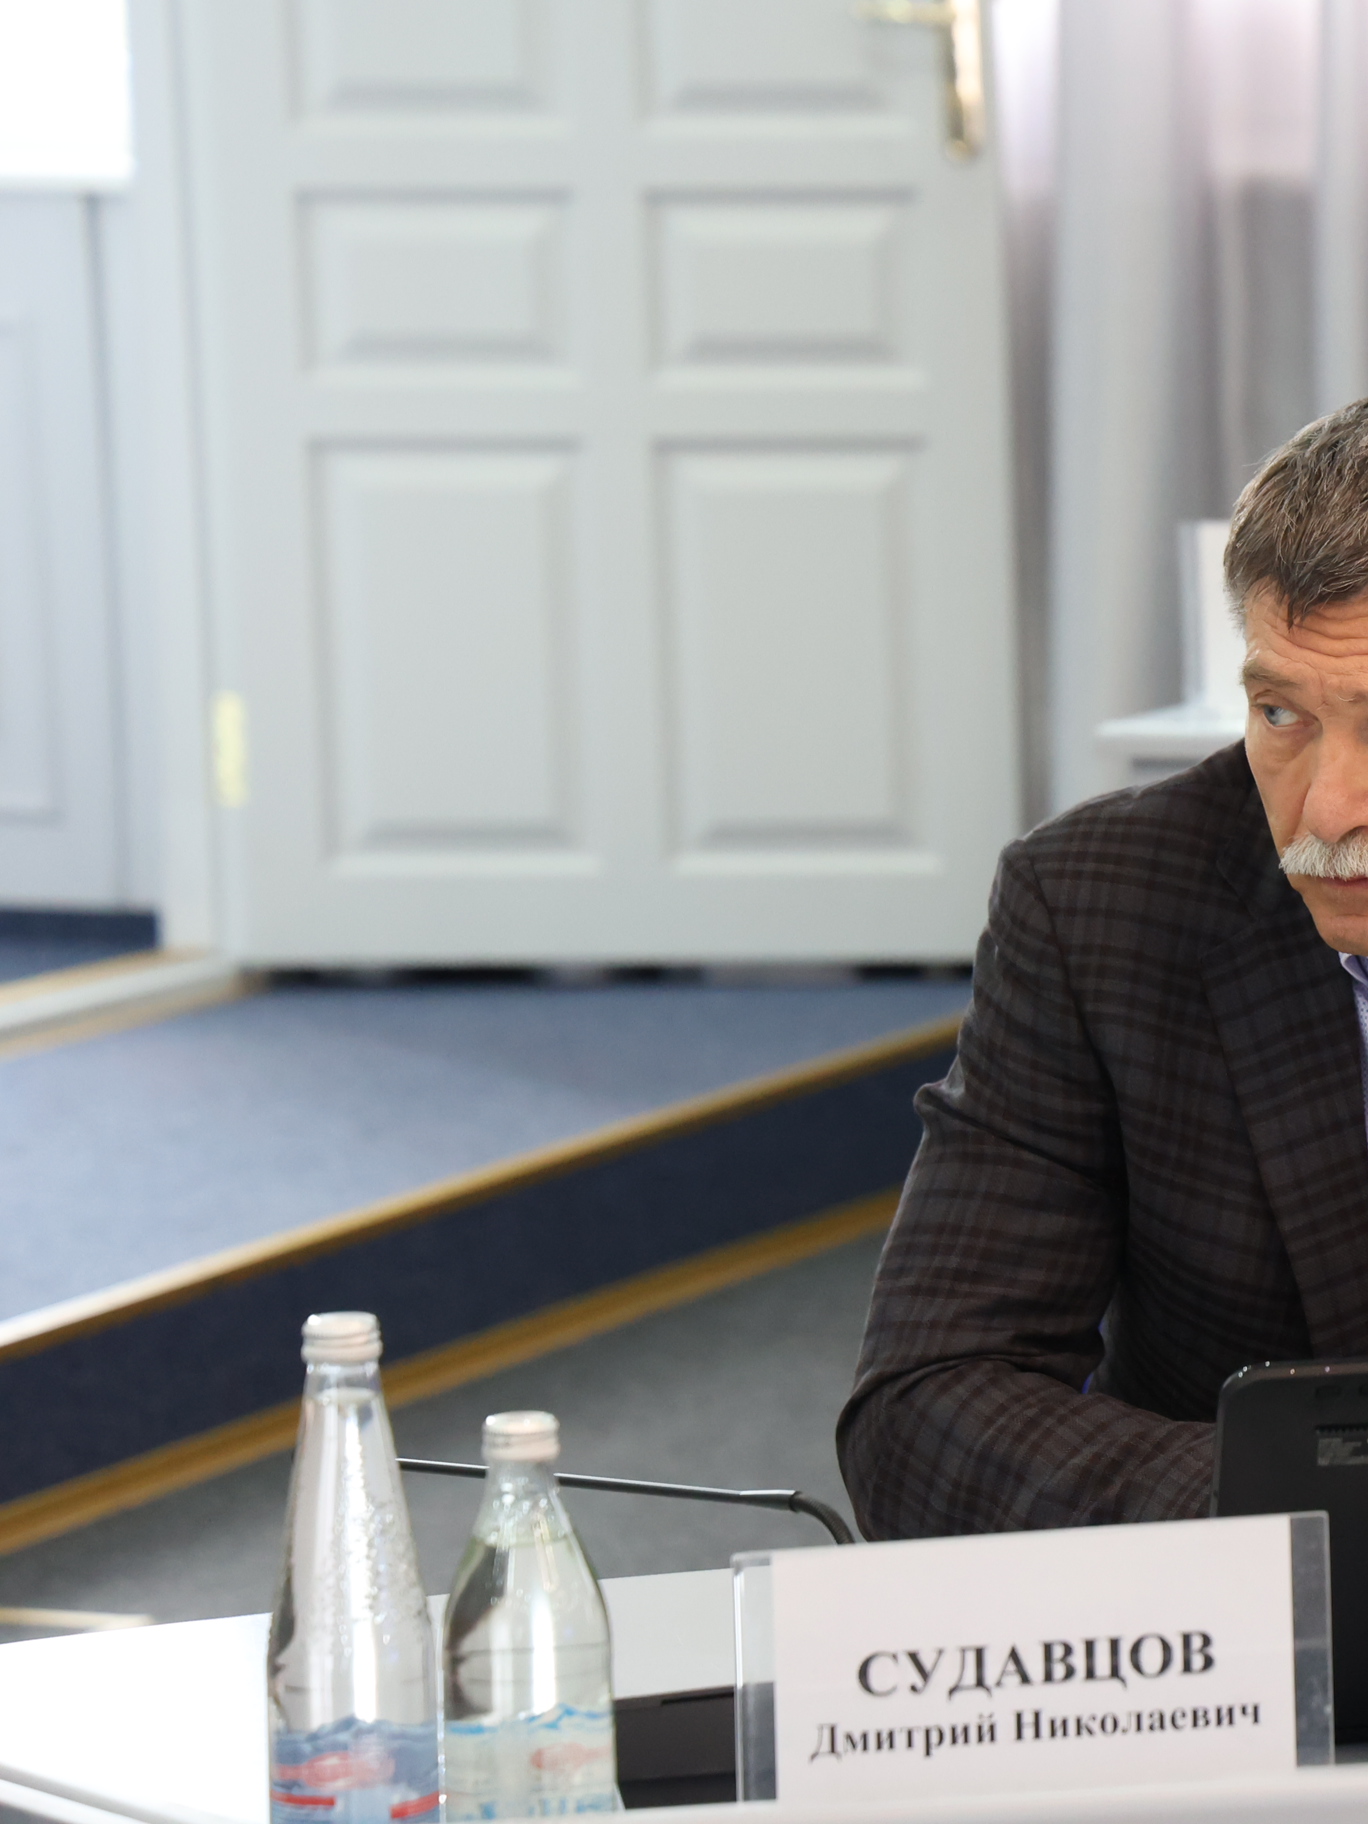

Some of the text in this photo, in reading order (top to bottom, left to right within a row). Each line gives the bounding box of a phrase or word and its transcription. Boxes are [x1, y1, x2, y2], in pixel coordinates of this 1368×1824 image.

[856, 1630, 1217, 1700] СУДАВЦОВ
[809, 1703, 1262, 1762] Дмитрий Николаевич
